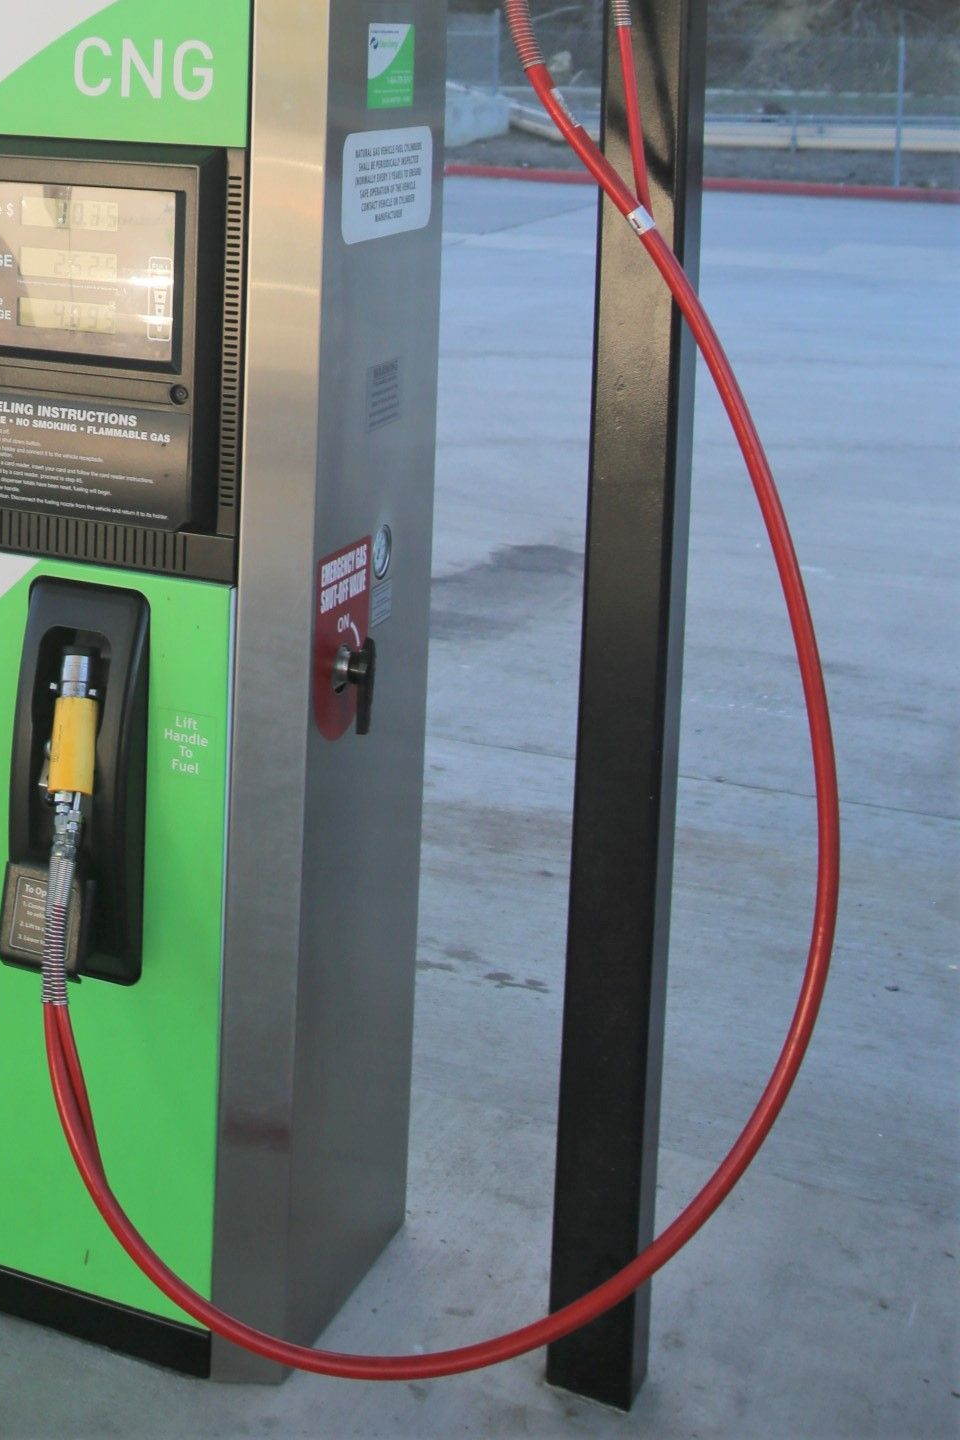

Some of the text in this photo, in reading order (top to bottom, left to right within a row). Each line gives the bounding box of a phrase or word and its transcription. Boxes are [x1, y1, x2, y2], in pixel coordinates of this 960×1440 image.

[73, 36, 214, 100] CNG
[6, 203, 14, 216] $
[38, 406, 137, 426] INSTRUCTIONS
[16, 418, 29, 427] NO
[32, 419, 77, 432] SMOKING
[87, 426, 148, 440] FLAMMABLE
[150, 432, 170, 443] GAS
[322, 544, 367, 587] EMERGENCY GAS
[321, 578, 349, 614] SHUT-OFF
[350, 568, 366, 598] VALVE
[338, 613, 350, 632] ON
[176, 715, 197, 731] Lift
[164, 728, 208, 747] Handle
[180, 746, 193, 758] To
[172, 758, 200, 775] Fuel
[25, 884, 33, 893] To
